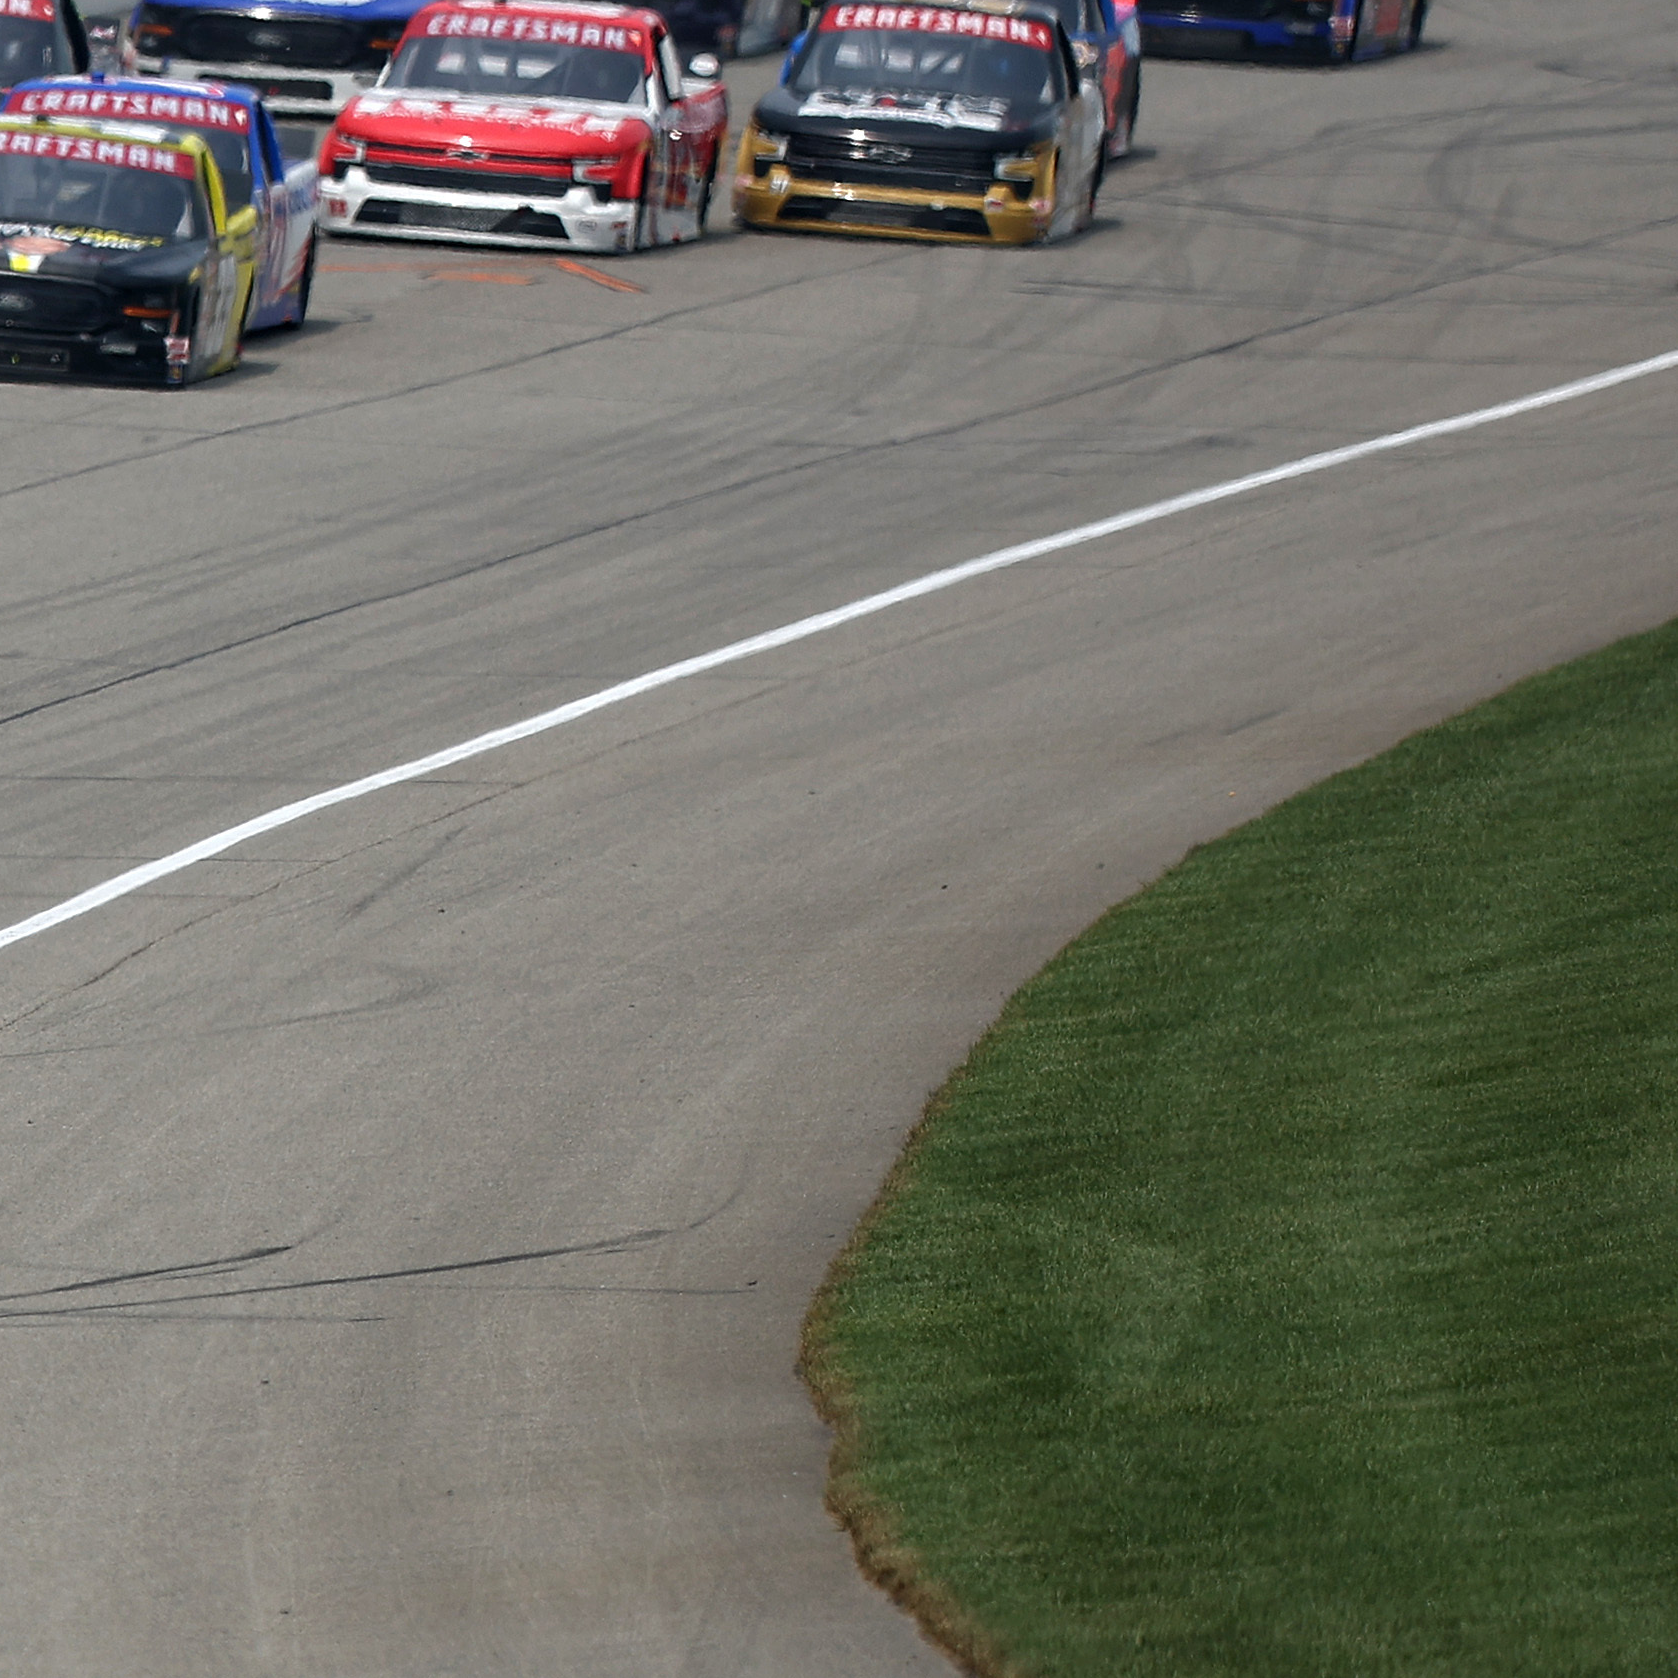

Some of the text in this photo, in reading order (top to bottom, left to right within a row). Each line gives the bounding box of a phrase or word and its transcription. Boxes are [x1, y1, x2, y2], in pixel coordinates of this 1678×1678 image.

[426, 14, 625, 50] CRAFTSMAN
[835, 5, 1031, 43] CRAFTSMAN
[21, 90, 229, 126] CRAFTSMAN
